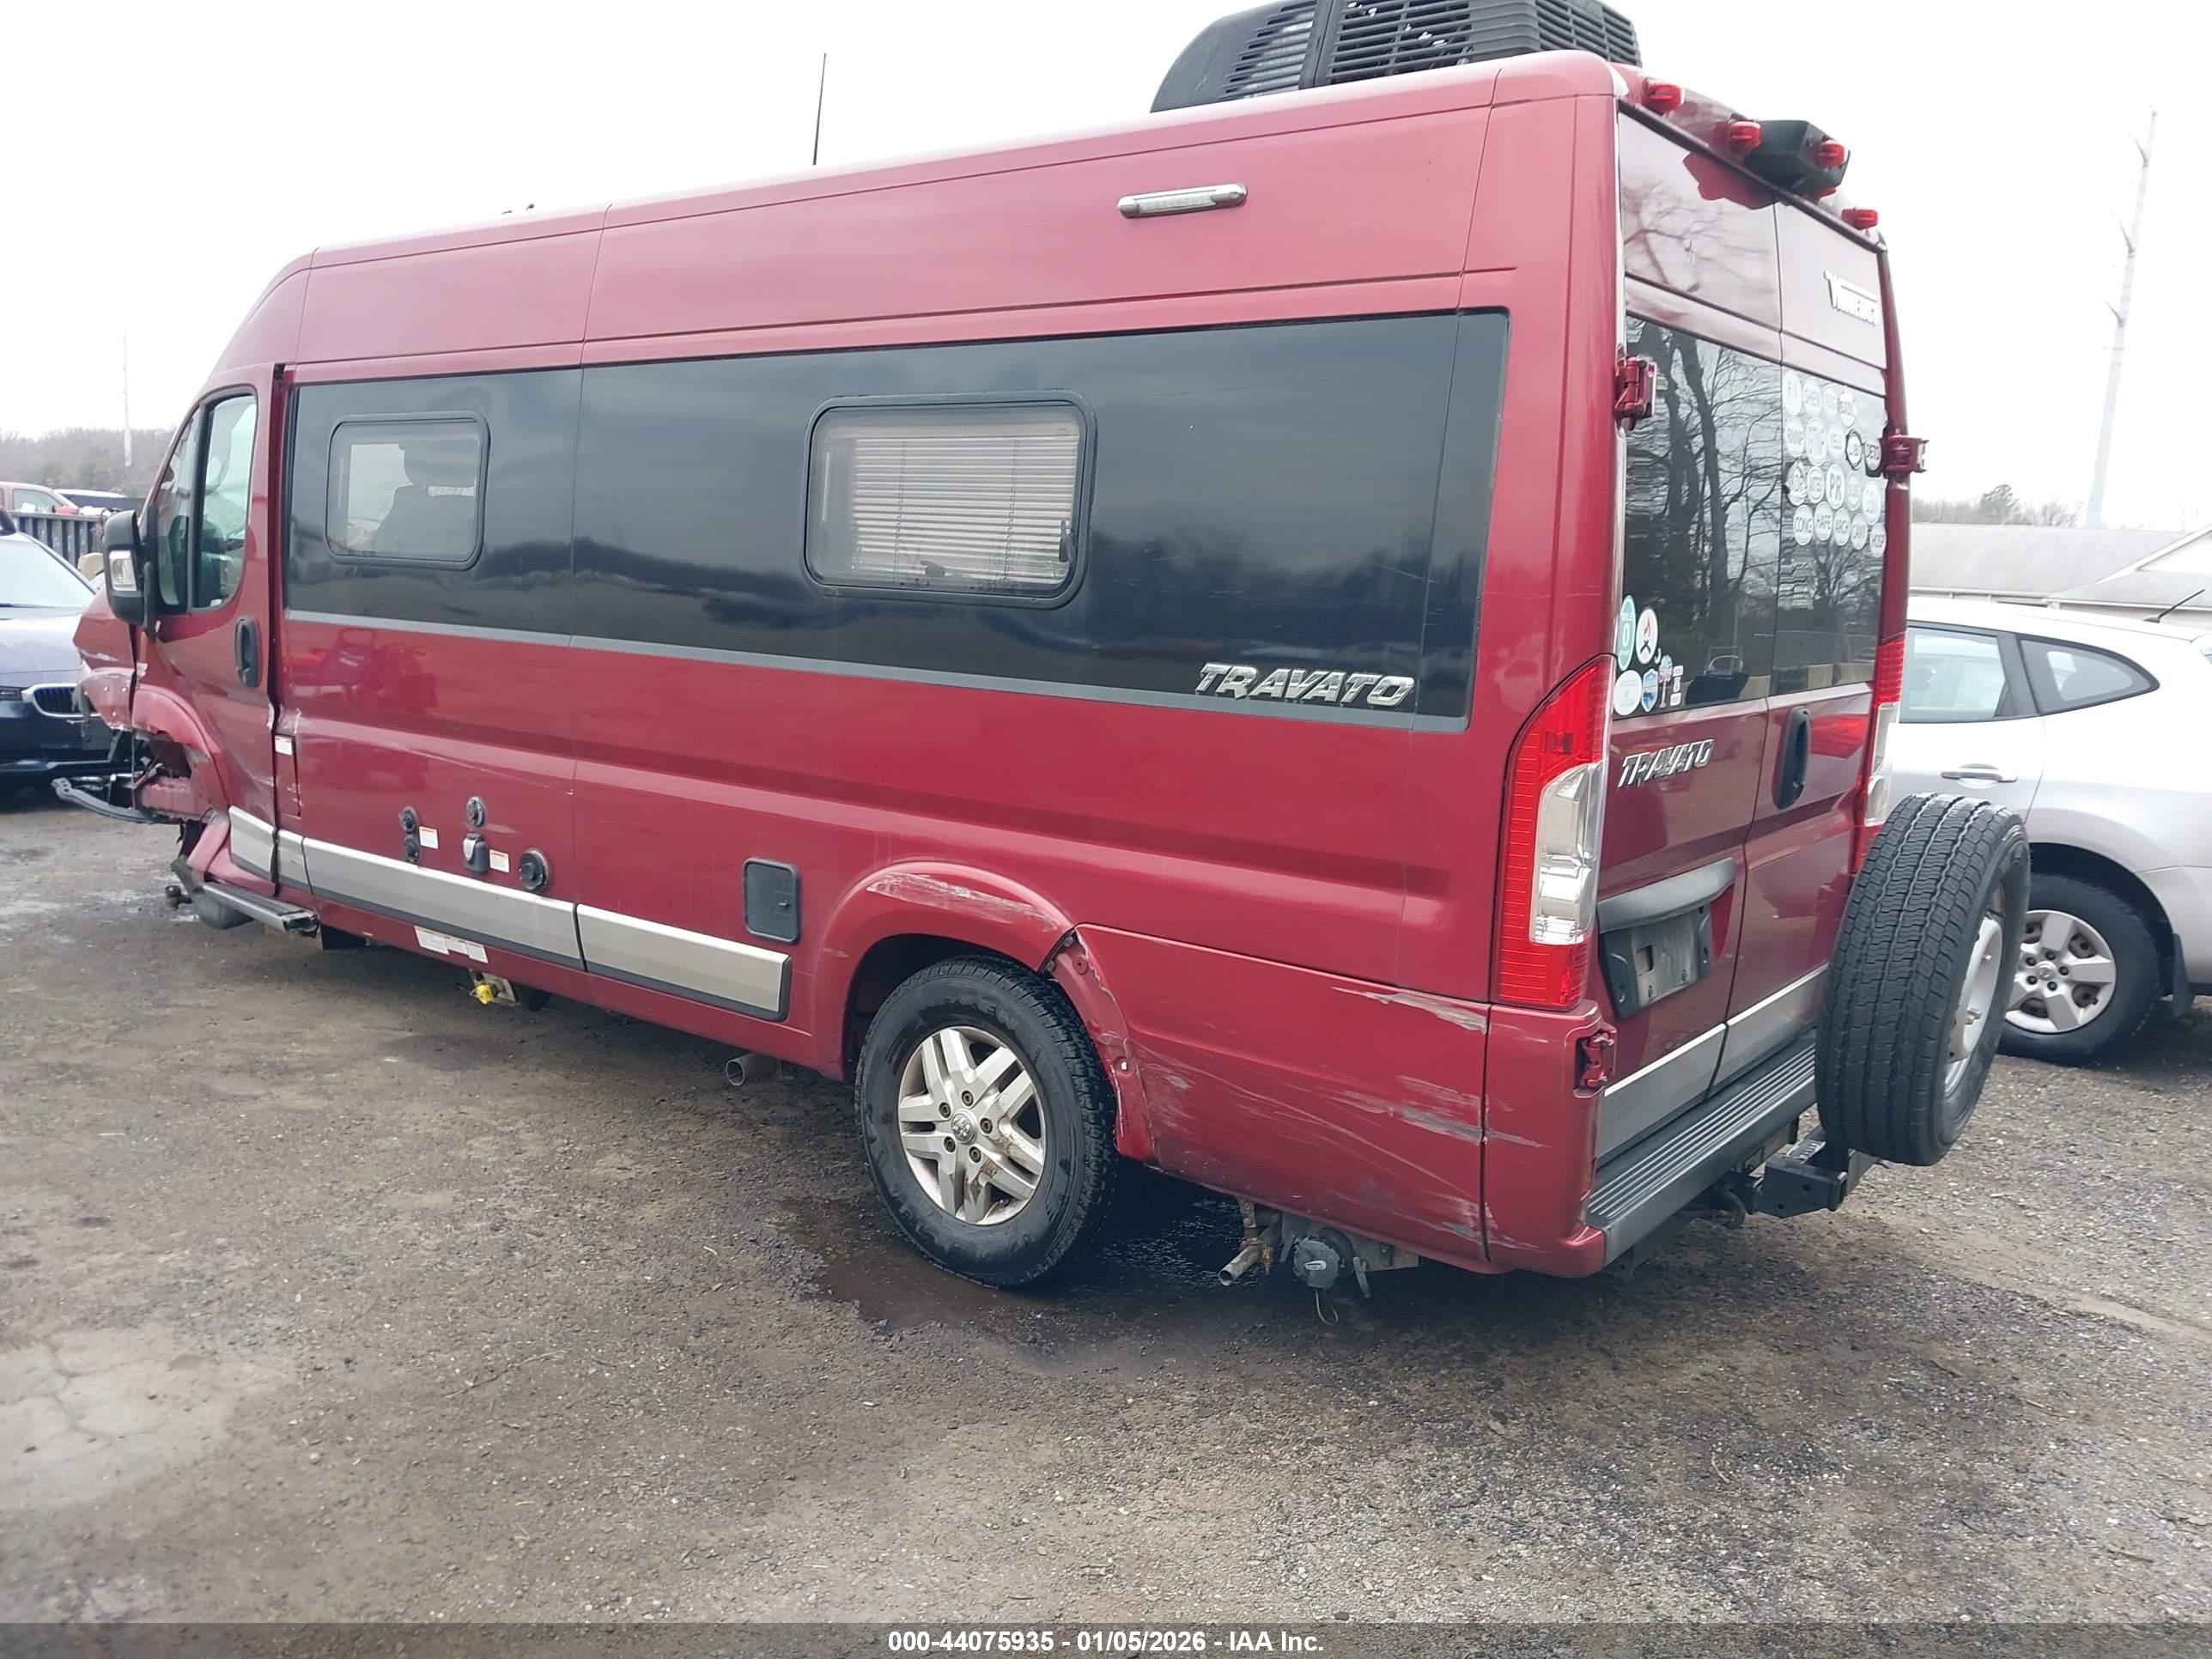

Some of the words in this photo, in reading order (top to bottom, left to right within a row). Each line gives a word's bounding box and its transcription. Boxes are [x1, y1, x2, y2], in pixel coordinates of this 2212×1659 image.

[1829, 473, 1842, 501] PR
[1194, 661, 1415, 708] TRAVATO
[1618, 739, 1714, 787] TRAVATO
